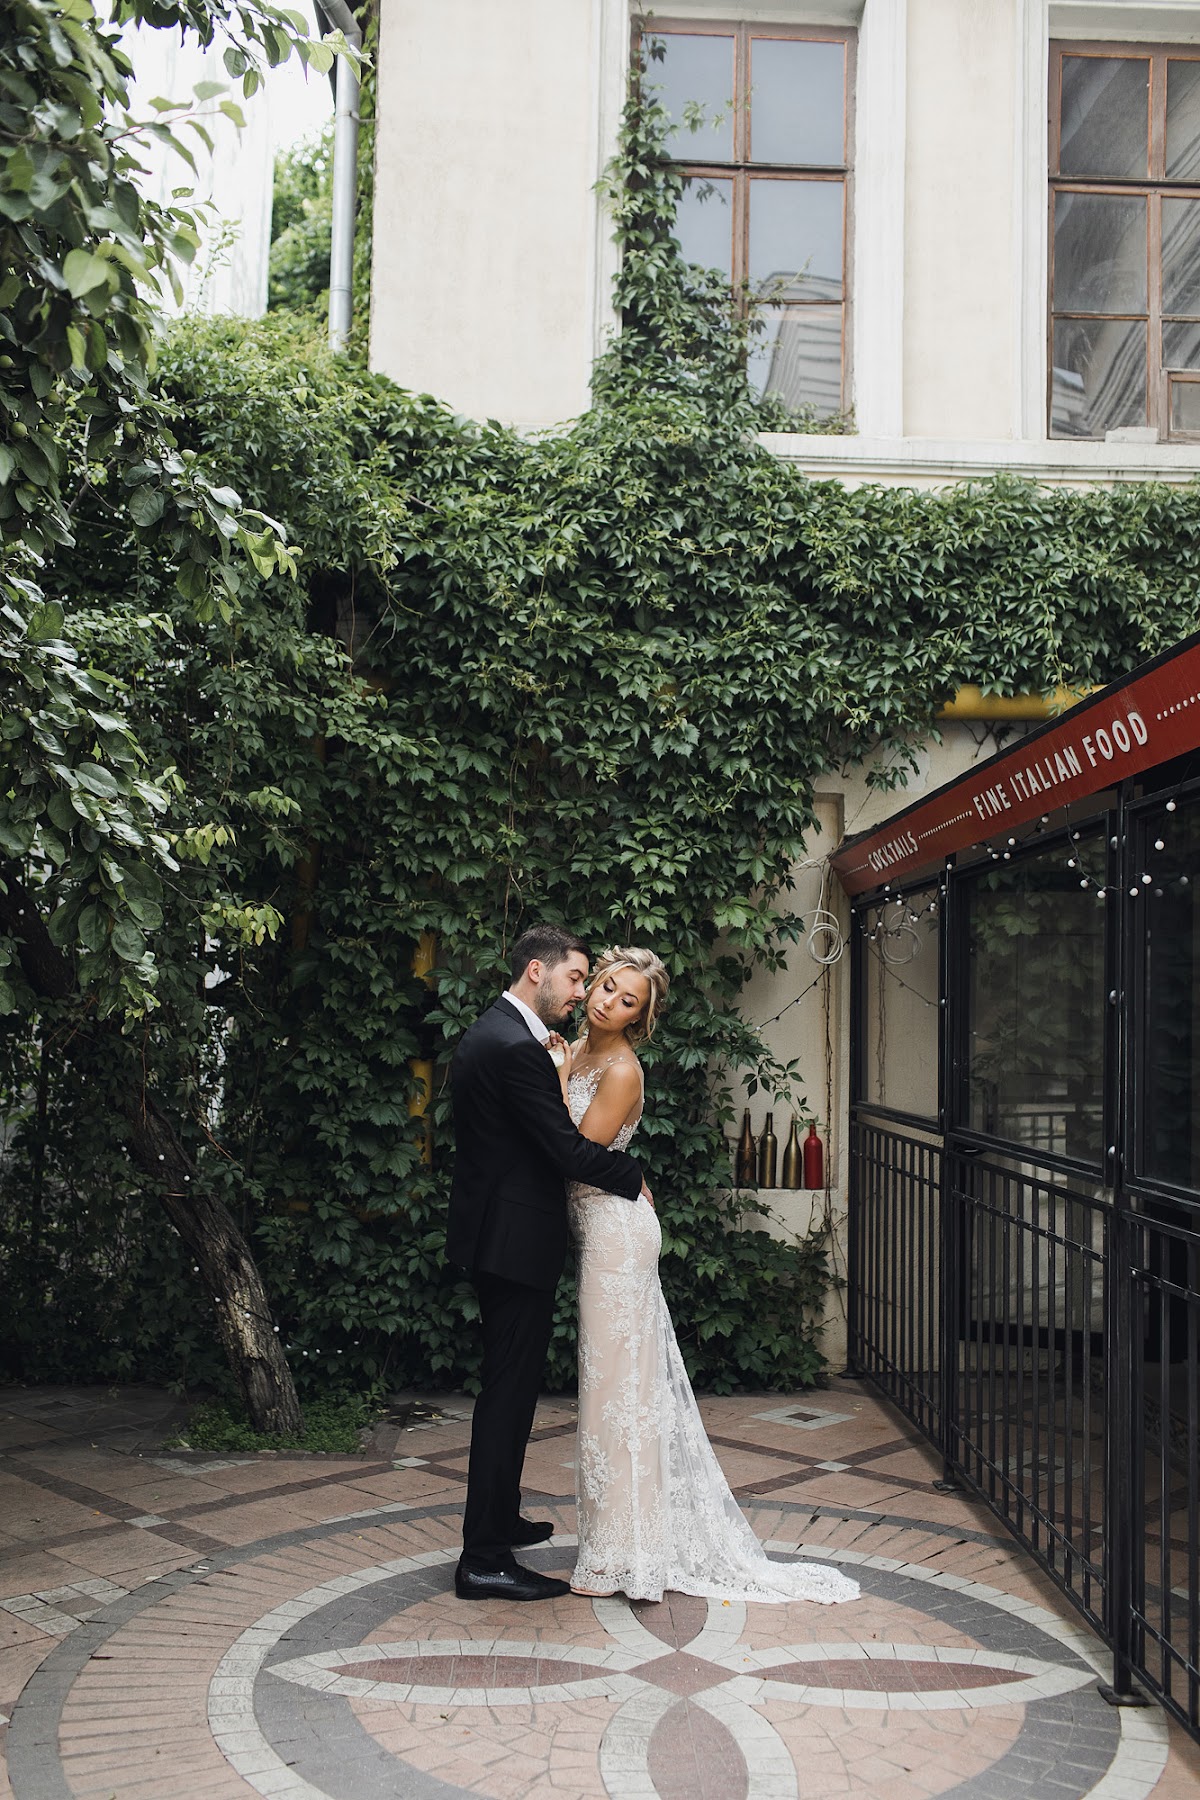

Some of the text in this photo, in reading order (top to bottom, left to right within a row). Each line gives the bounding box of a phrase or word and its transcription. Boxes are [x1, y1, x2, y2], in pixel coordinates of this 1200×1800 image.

[868, 712, 1148, 872] COCKTAILS FINE ITALIAN FOOD
